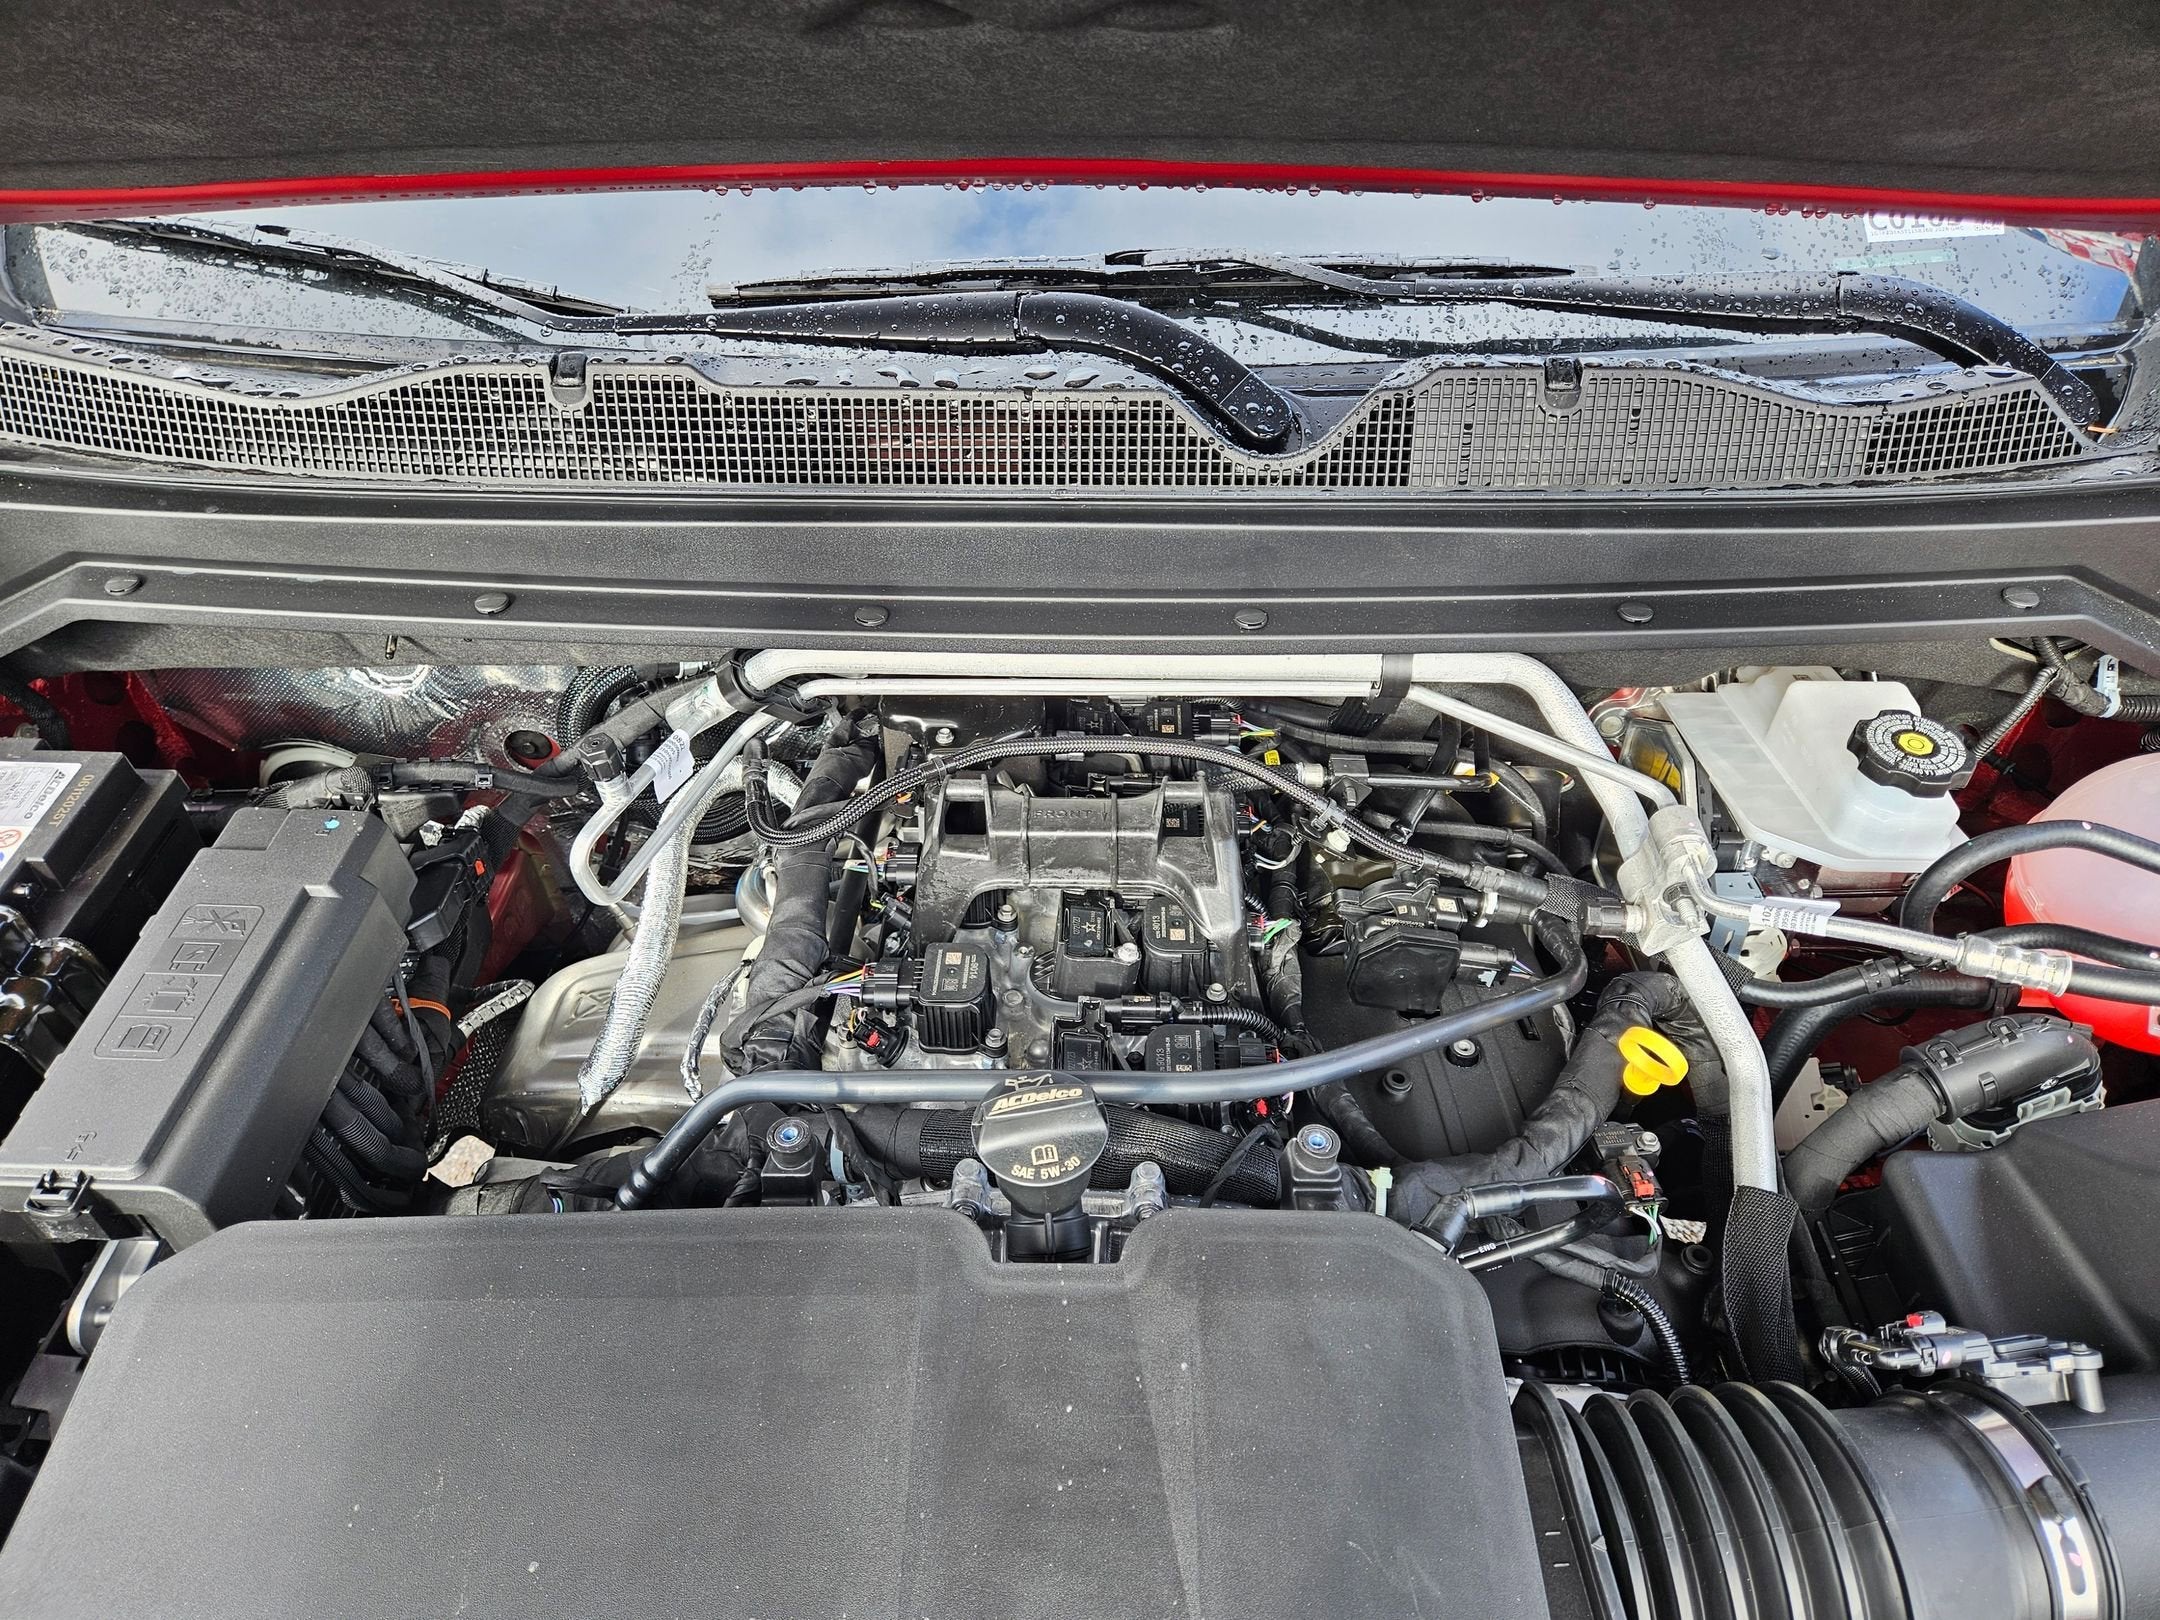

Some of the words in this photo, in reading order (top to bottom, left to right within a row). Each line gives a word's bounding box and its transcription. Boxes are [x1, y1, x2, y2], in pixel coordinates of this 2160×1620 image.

[24, 769, 67, 819] ACDelco
[1033, 809, 1093, 819] FRONT
[991, 1088, 1083, 1112] ACDelco
[1011, 1164, 1035, 1180] SAE
[1040, 1156, 1081, 1180] 5W-30
